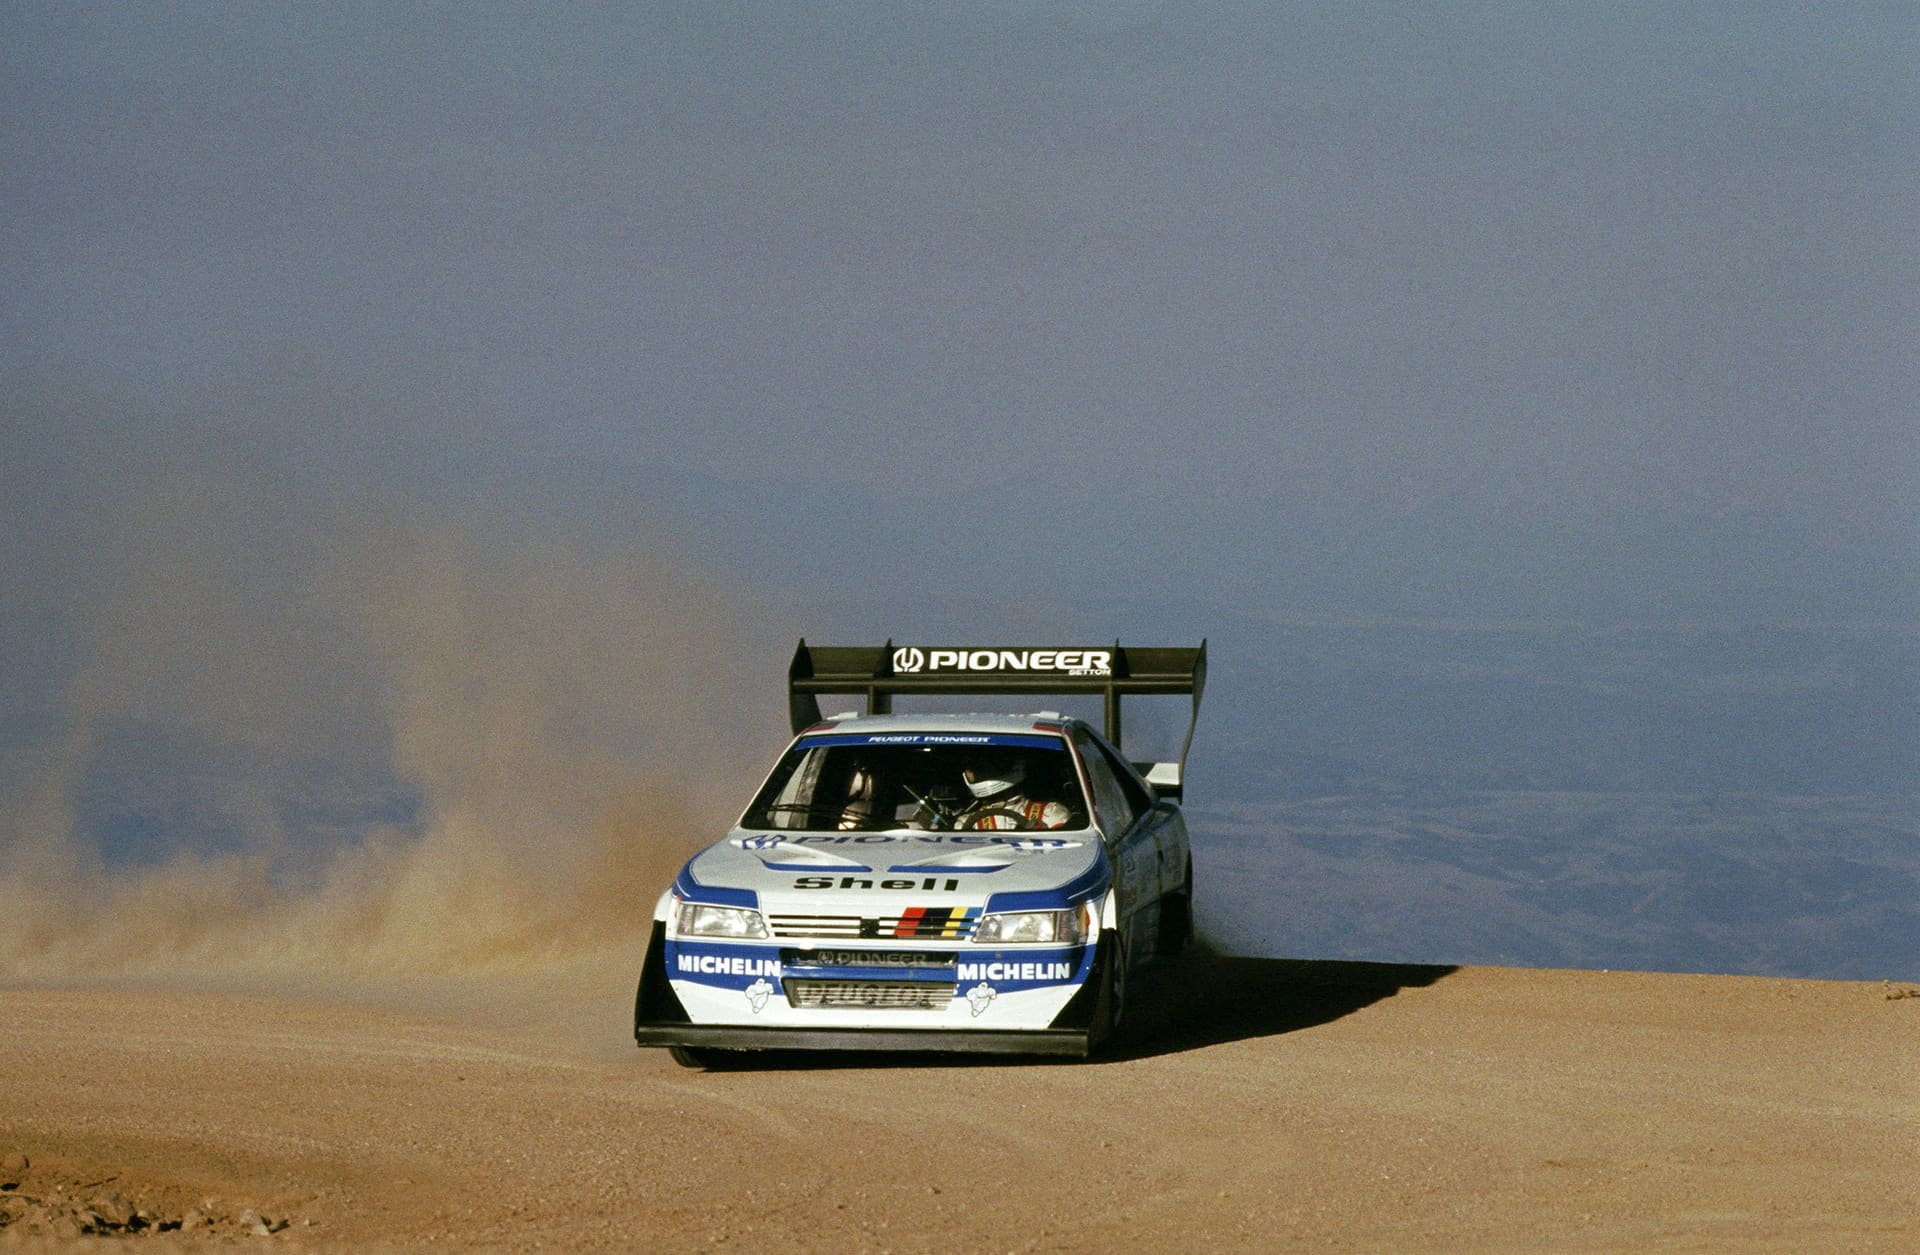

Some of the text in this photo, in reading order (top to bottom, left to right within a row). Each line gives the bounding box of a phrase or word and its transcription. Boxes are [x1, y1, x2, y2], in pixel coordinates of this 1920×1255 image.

[929, 650, 1112, 669] PIONEER
[1068, 668, 1112, 676] SETTON
[868, 735, 991, 744] PEUGEOT PIONEER
[793, 876, 959, 891] Shell
[677, 954, 781, 977] MICHELIN
[957, 963, 1069, 980] MICHELIN
